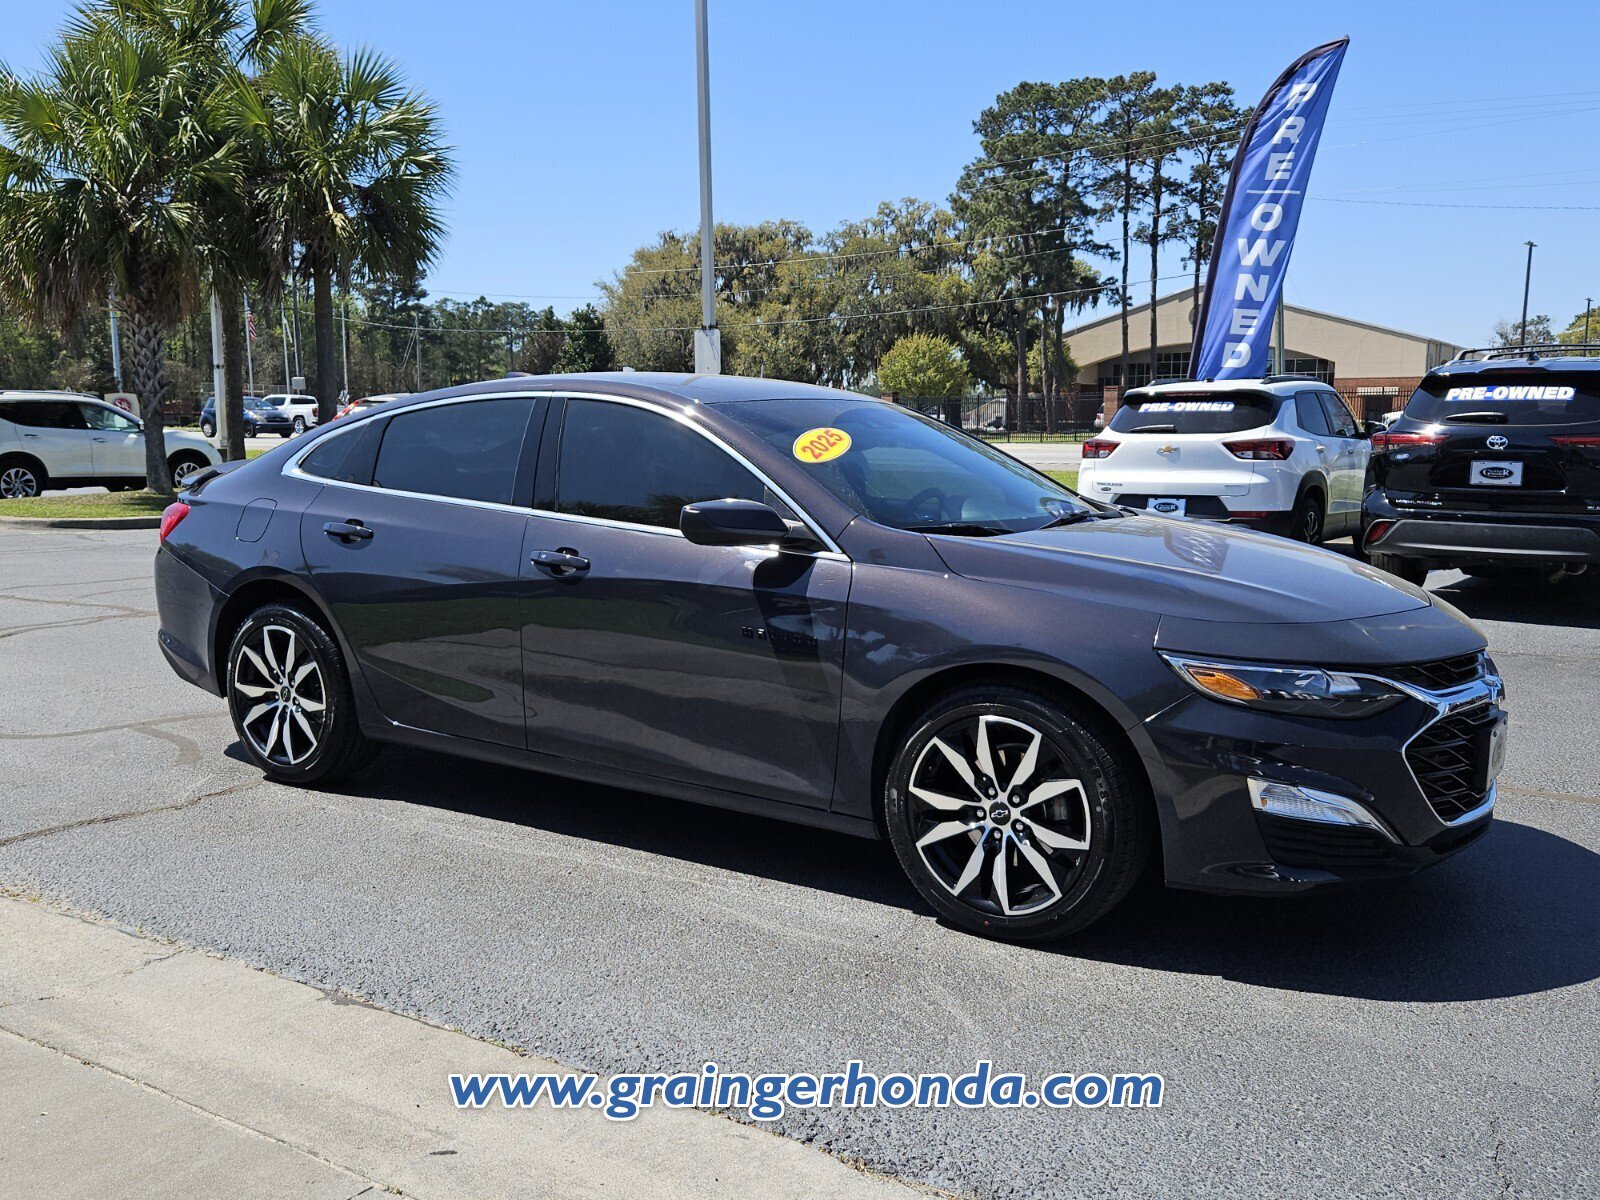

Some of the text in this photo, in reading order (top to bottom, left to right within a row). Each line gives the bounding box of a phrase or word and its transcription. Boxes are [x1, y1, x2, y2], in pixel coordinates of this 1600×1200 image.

[1221, 82, 1317, 368] PRE OWNED
[1444, 386, 1576, 401] PRE-OWNED
[1138, 402, 1235, 413] PRE-OWNED
[801, 429, 843, 460] 2025
